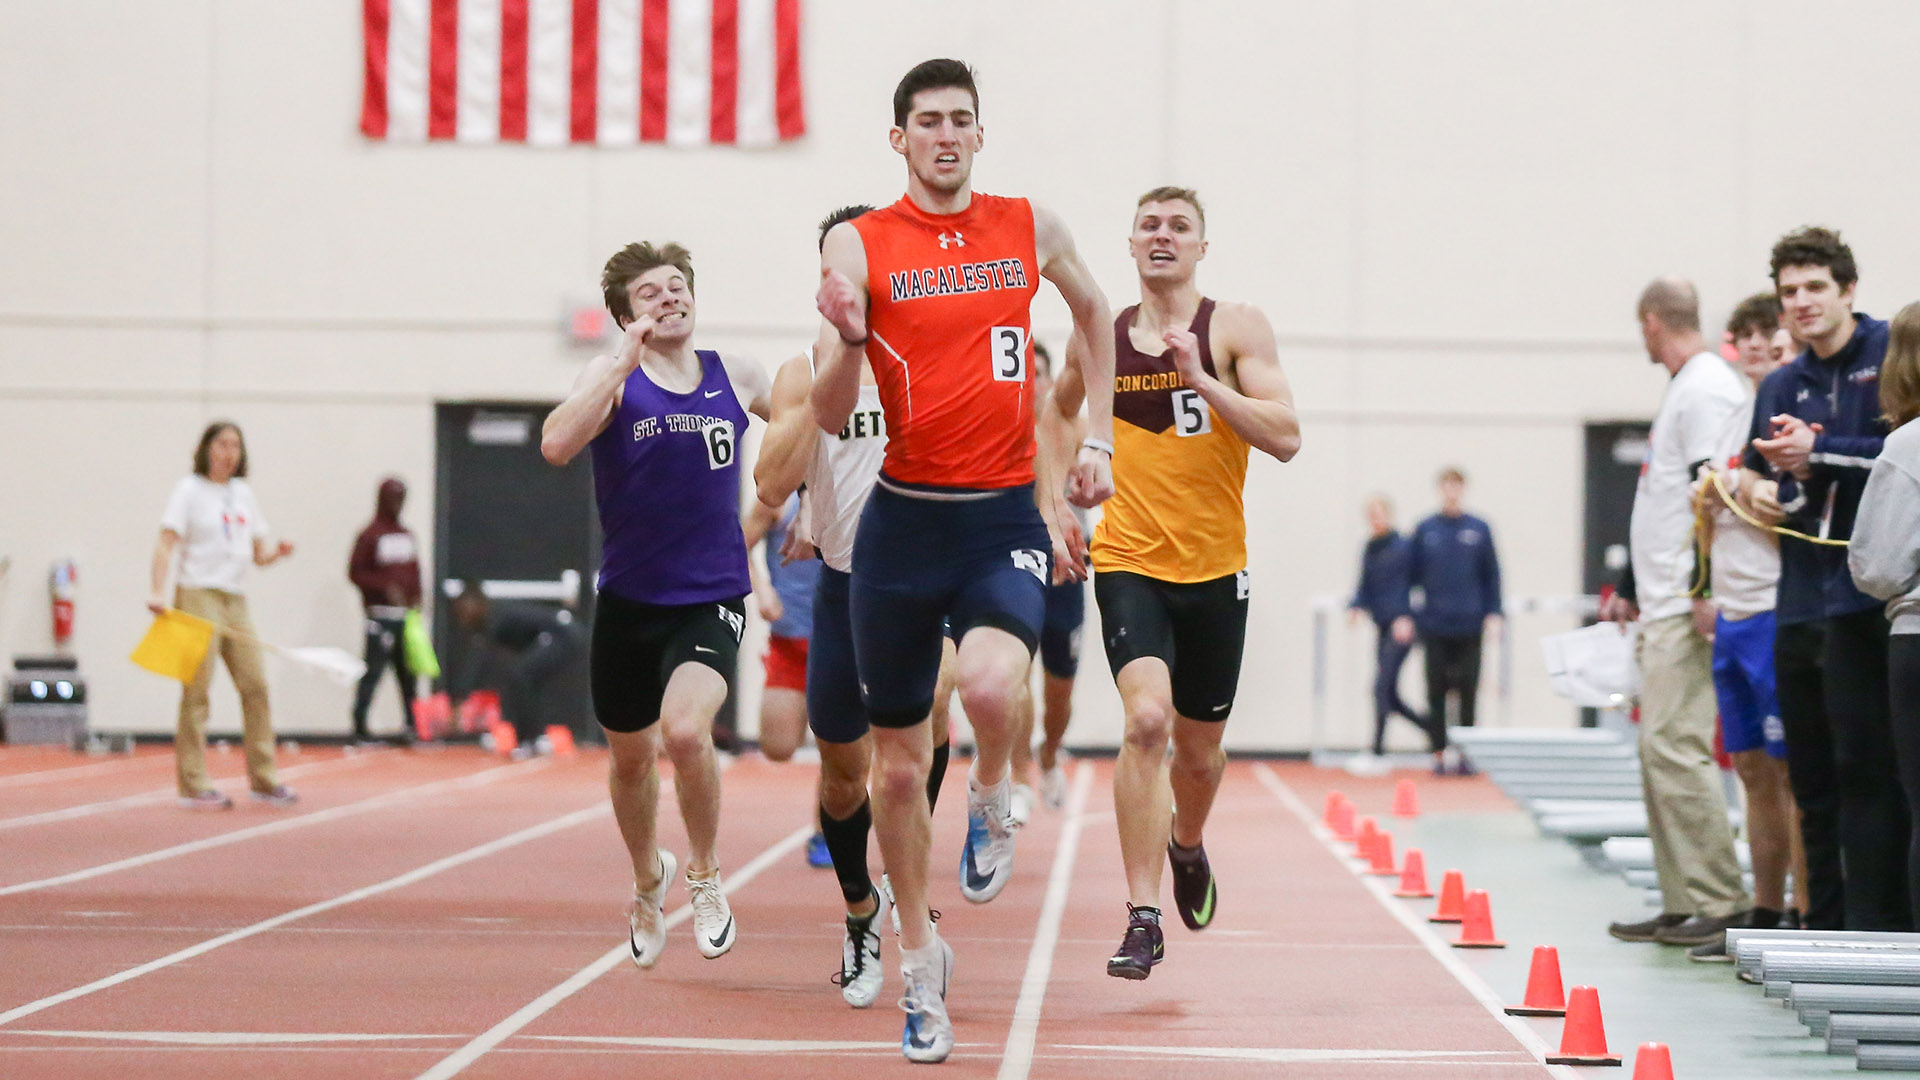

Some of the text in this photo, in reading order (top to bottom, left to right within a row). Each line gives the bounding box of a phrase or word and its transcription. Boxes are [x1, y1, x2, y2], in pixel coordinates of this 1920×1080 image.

[890, 258, 1027, 302] MACALESTER
[1000, 330, 1020, 378] 3
[1115, 371, 1184, 393] CONCORDI
[633, 413, 734, 441] ST. THOM
[1181, 393, 1203, 434] 5
[709, 426, 731, 465] 6
